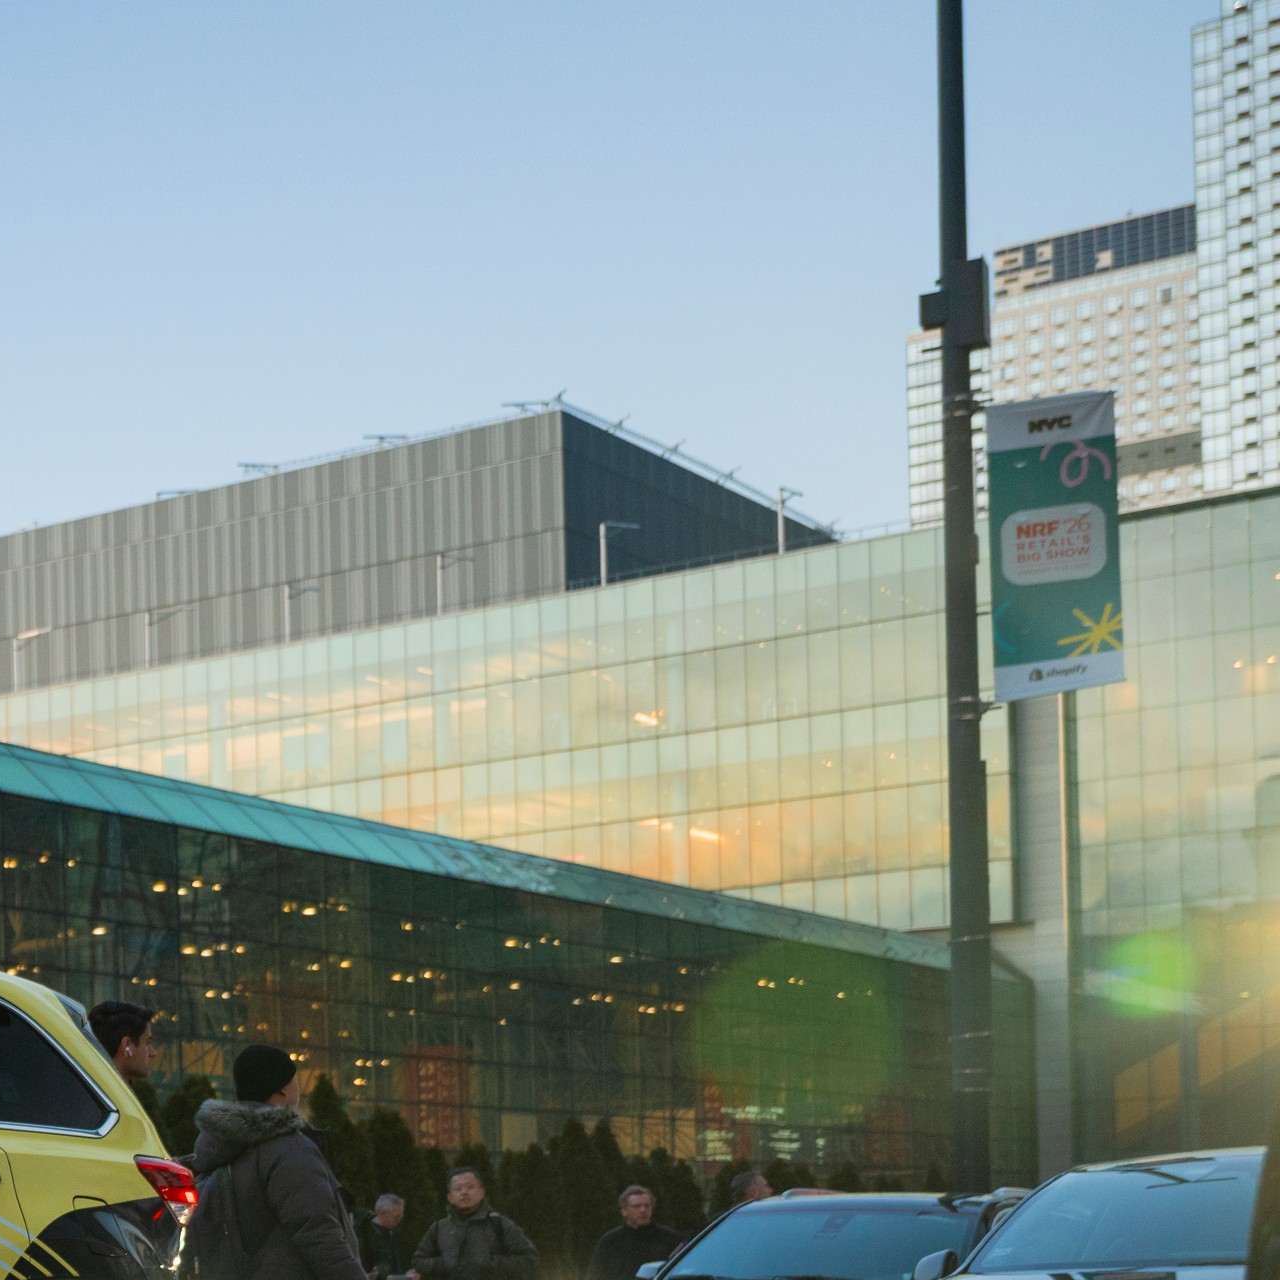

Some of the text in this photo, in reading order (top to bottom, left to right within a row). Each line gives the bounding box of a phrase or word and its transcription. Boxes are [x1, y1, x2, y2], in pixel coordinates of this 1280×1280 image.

[1028, 415, 1072, 434] NYC
[1016, 520, 1060, 539] NRF
[1016, 535, 1090, 551] RETAIL'S
[1017, 546, 1089, 564] BIG SHOW
[1047, 662, 1088, 677] shopify
